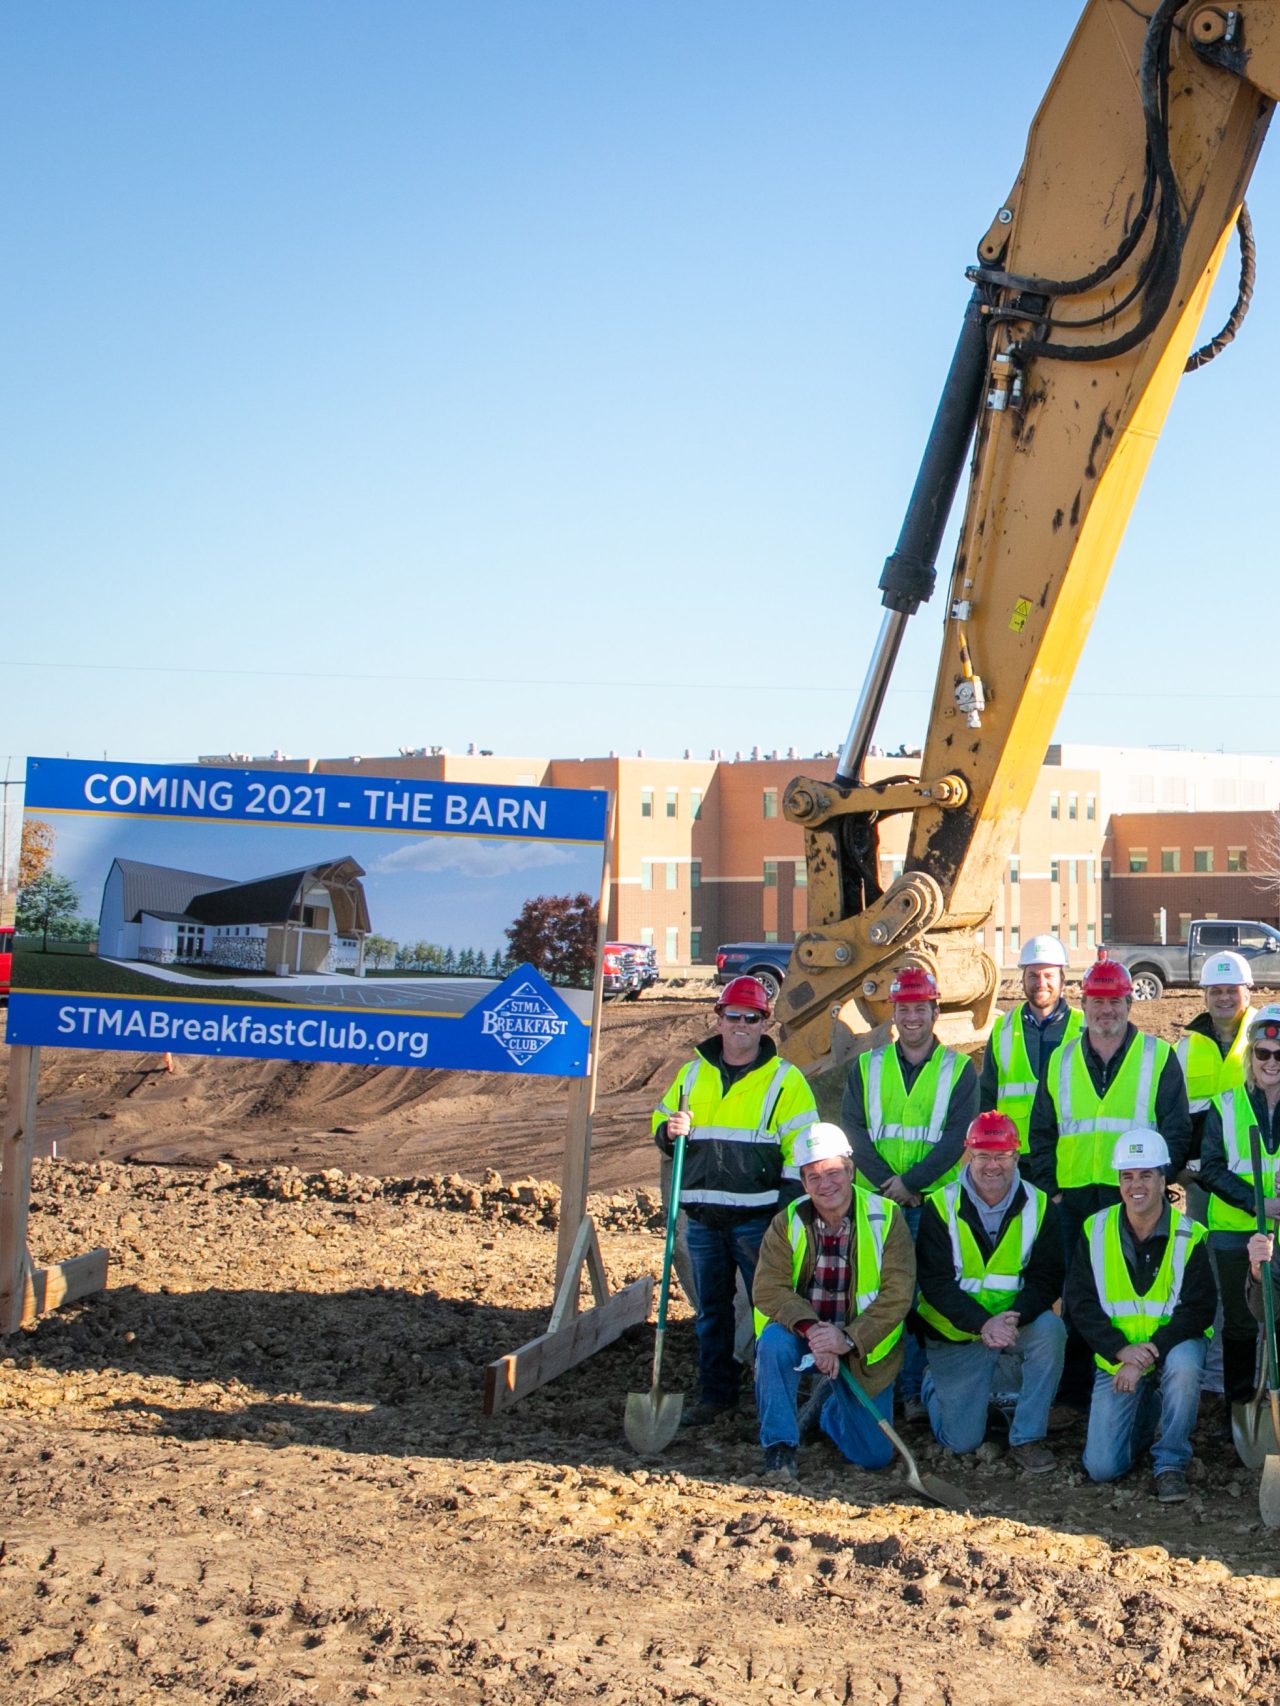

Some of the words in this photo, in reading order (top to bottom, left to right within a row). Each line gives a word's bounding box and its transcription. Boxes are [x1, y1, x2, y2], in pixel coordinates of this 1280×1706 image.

[84, 773, 233, 811] COMING
[245, 783, 326, 817] 2021
[363, 790, 434, 823] THE
[445, 795, 547, 830] BARN
[511, 1001, 540, 1013] STMA
[57, 1005, 429, 1058] STMABreakfastClub.org
[481, 1010, 568, 1035] BREAKFAST
[509, 1039, 538, 1051] CLUB
